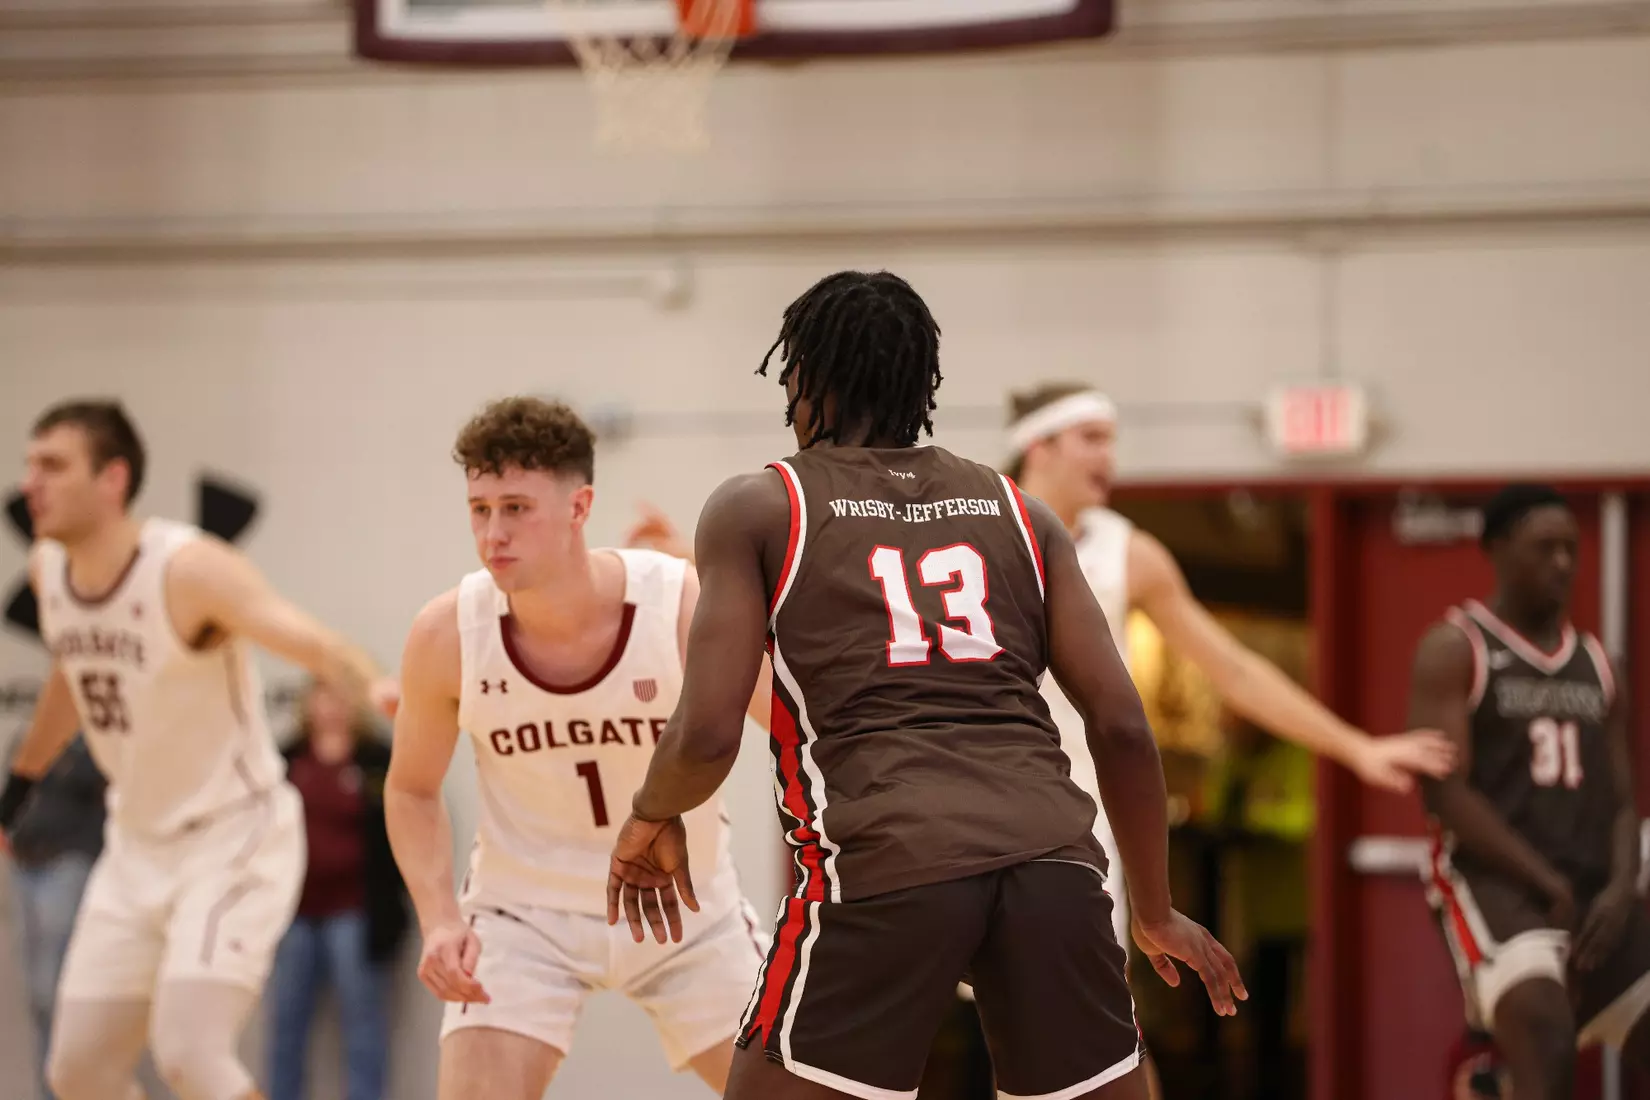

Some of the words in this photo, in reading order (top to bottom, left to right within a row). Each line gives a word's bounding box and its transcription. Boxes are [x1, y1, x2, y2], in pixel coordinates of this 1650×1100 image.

[829, 498, 1001, 523] WRISBY-JEFFERSON
[868, 541, 1006, 667] 13
[1528, 716, 1584, 789] 31
[576, 759, 610, 828] 1
